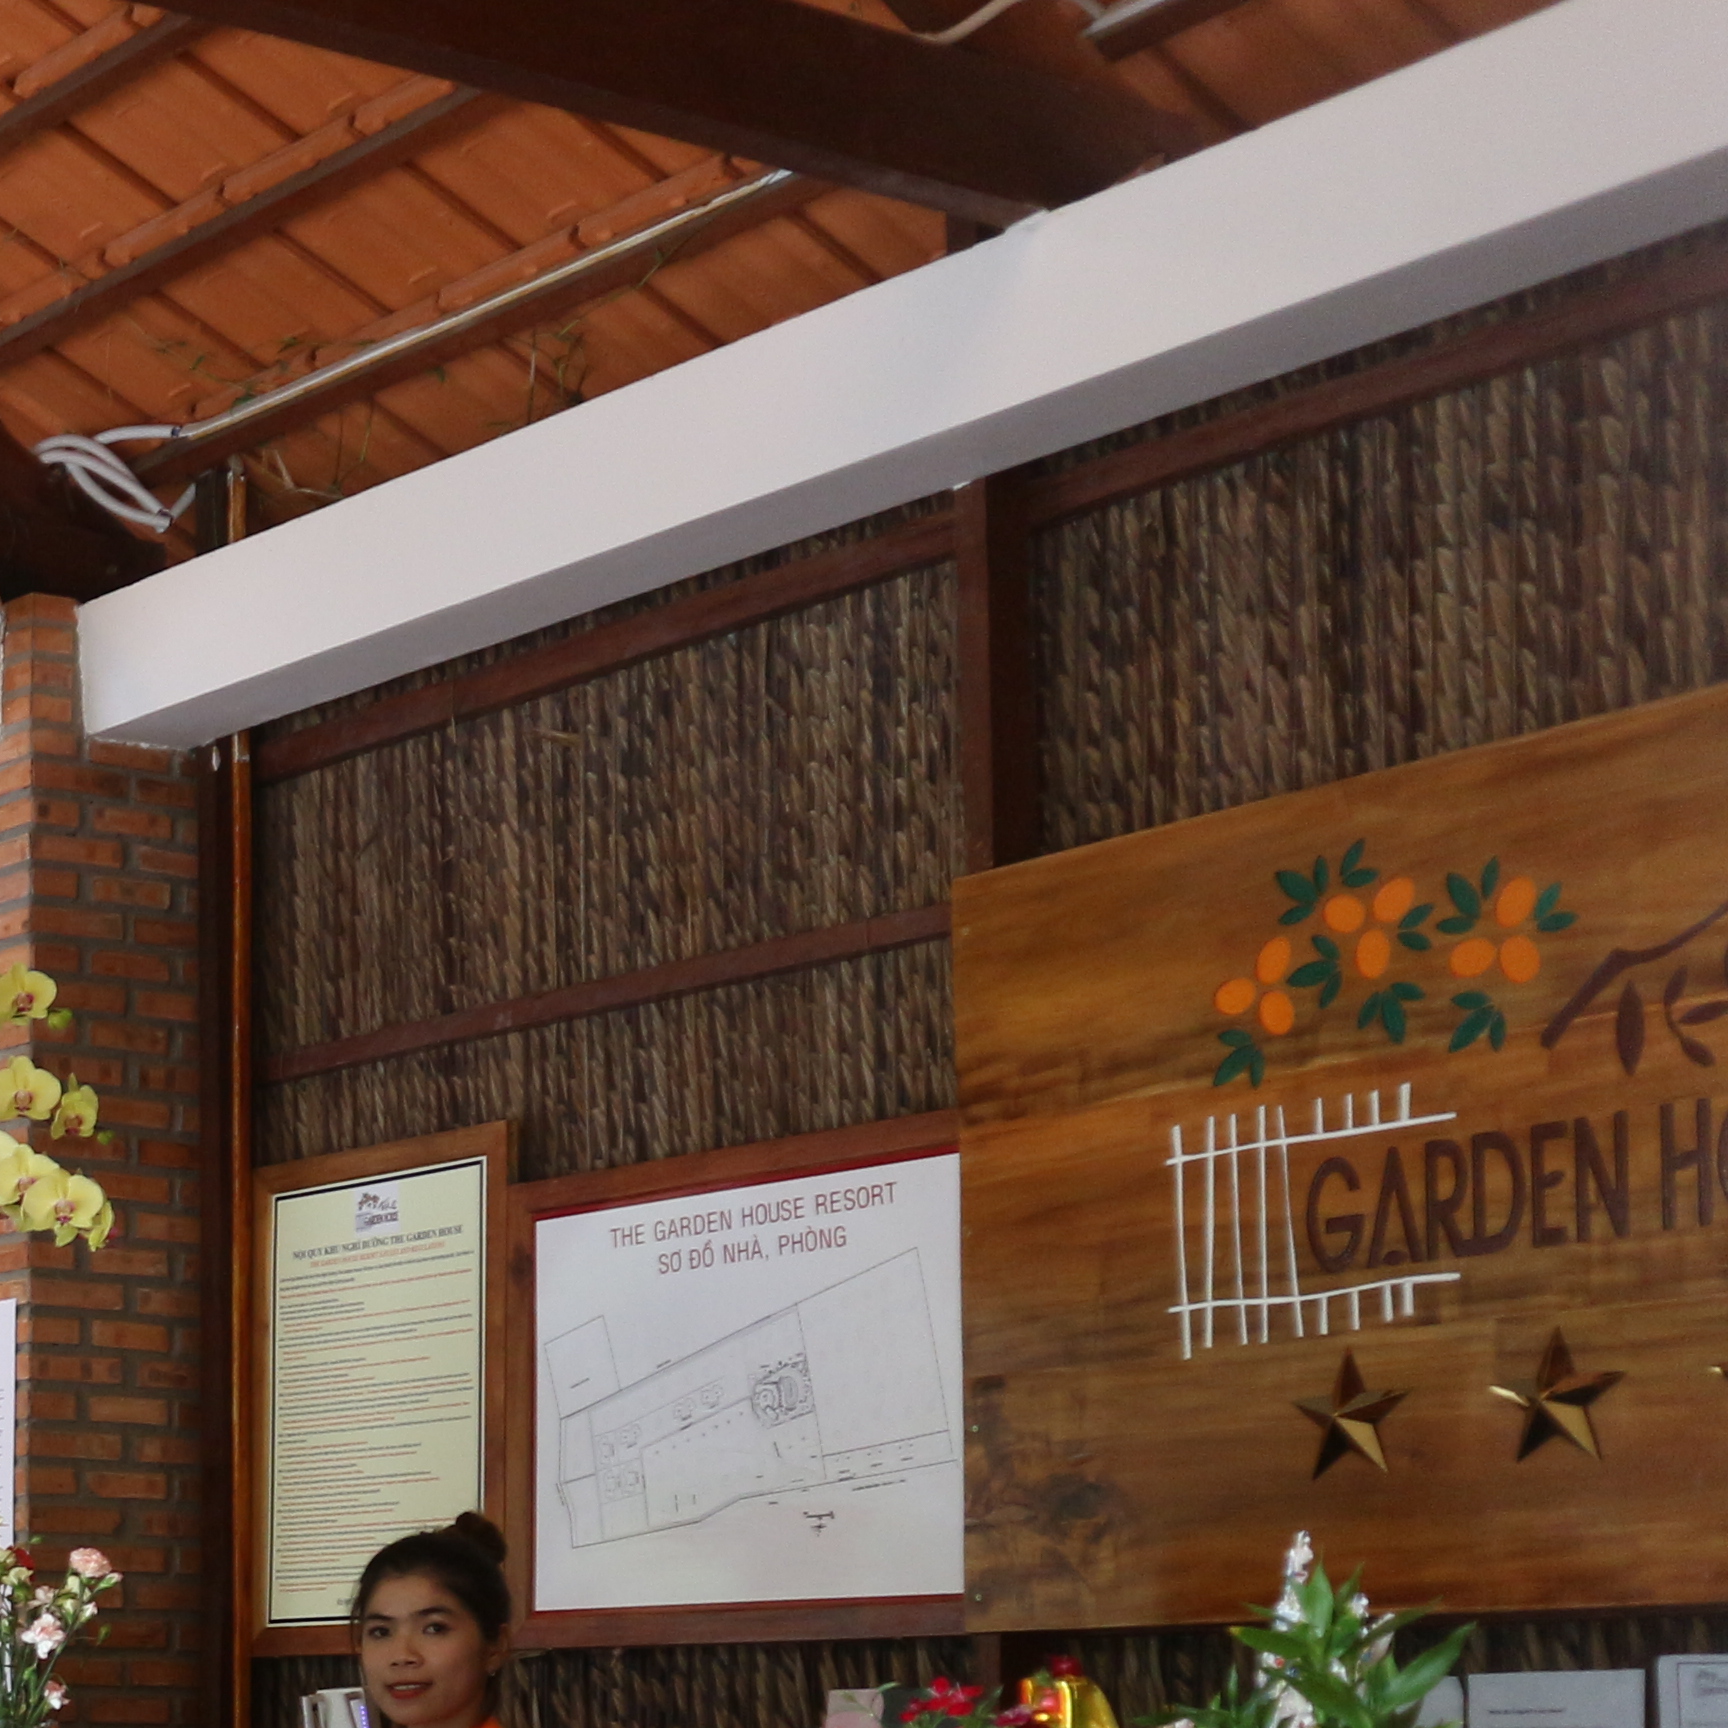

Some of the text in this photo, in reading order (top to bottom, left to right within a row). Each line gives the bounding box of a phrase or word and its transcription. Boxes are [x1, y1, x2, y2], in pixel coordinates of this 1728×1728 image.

[610, 1182, 897, 1248] THE GARDEN HOUSE RESORT
[1306, 1098, 1728, 1273] GARDEN H
[658, 1225, 847, 1275] SƠ ĐỒ NHÀ, PHÒNG
